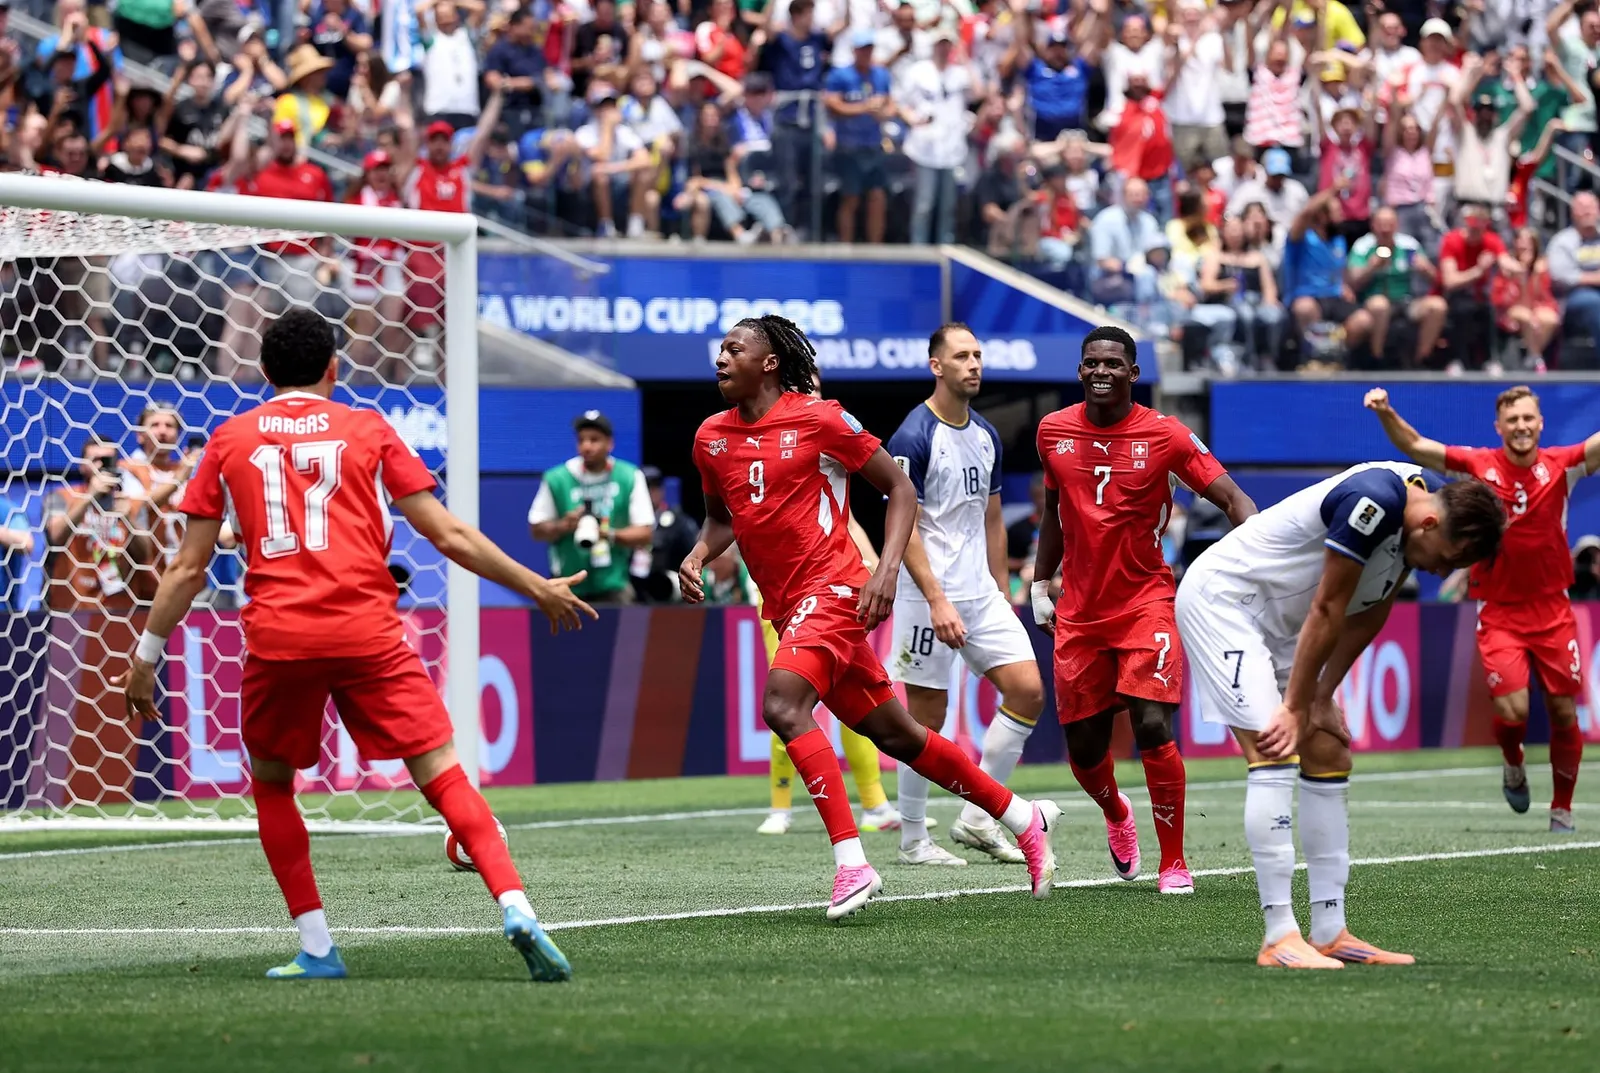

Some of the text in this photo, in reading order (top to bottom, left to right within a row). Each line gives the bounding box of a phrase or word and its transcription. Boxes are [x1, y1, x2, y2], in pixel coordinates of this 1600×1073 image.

[509, 295, 643, 333] WORLD
[644, 297, 718, 334] CUP
[258, 412, 330, 435] VARGAS
[248, 439, 348, 559] 17
[748, 460, 766, 504] 9
[962, 466, 980, 496] 18
[1093, 465, 1113, 506] 7
[1511, 489, 1528, 516] 3
[790, 595, 819, 625] 9
[909, 625, 935, 657] 18
[1153, 631, 1171, 670] 7
[1567, 638, 1582, 674] 3
[1223, 650, 1245, 689] 7
